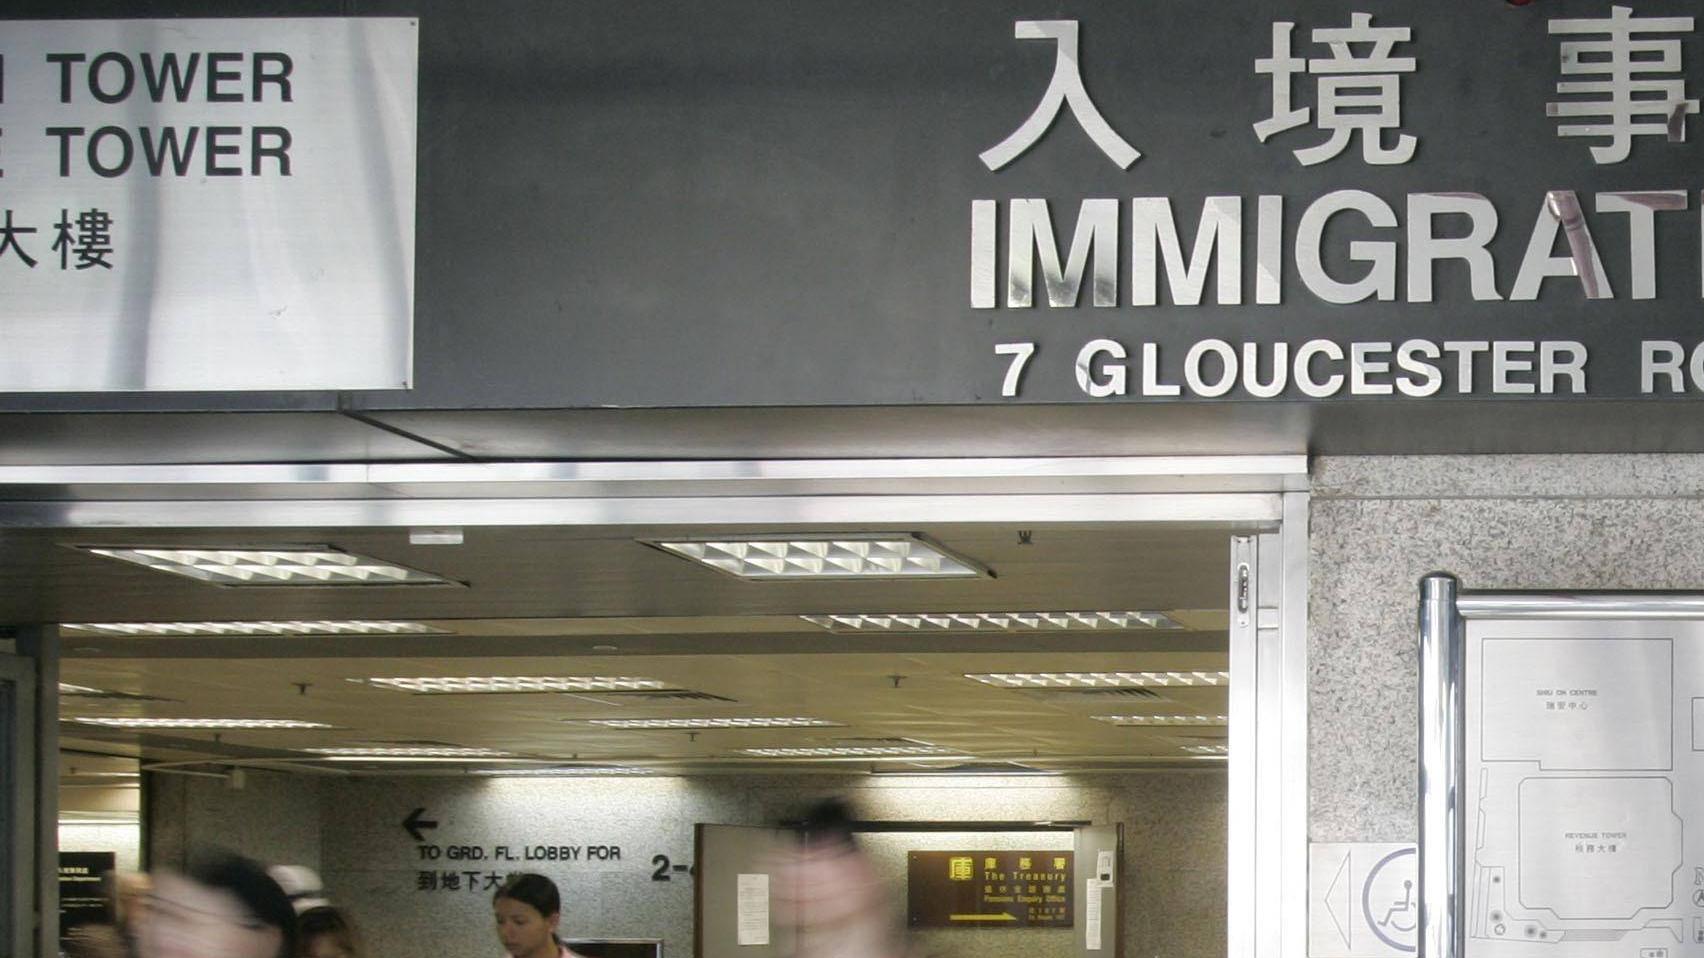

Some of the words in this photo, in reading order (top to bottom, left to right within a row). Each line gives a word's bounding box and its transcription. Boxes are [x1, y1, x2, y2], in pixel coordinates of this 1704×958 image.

[46, 51, 294, 104] TOWER
[46, 126, 292, 177] TOWER
[0, 208, 114, 271] 大樓
[994, 343, 1036, 397] 7
[1076, 339, 1587, 397] GLOUCESTER
[418, 845, 441, 860] TO
[446, 845, 487, 861] GRD.
[495, 845, 520, 861] FL.
[525, 846, 580, 861] LOBBY
[587, 846, 621, 861] FOR
[651, 854, 695, 882] 2-
[985, 872, 1005, 881] The
[1013, 872, 1066, 882] Treasury
